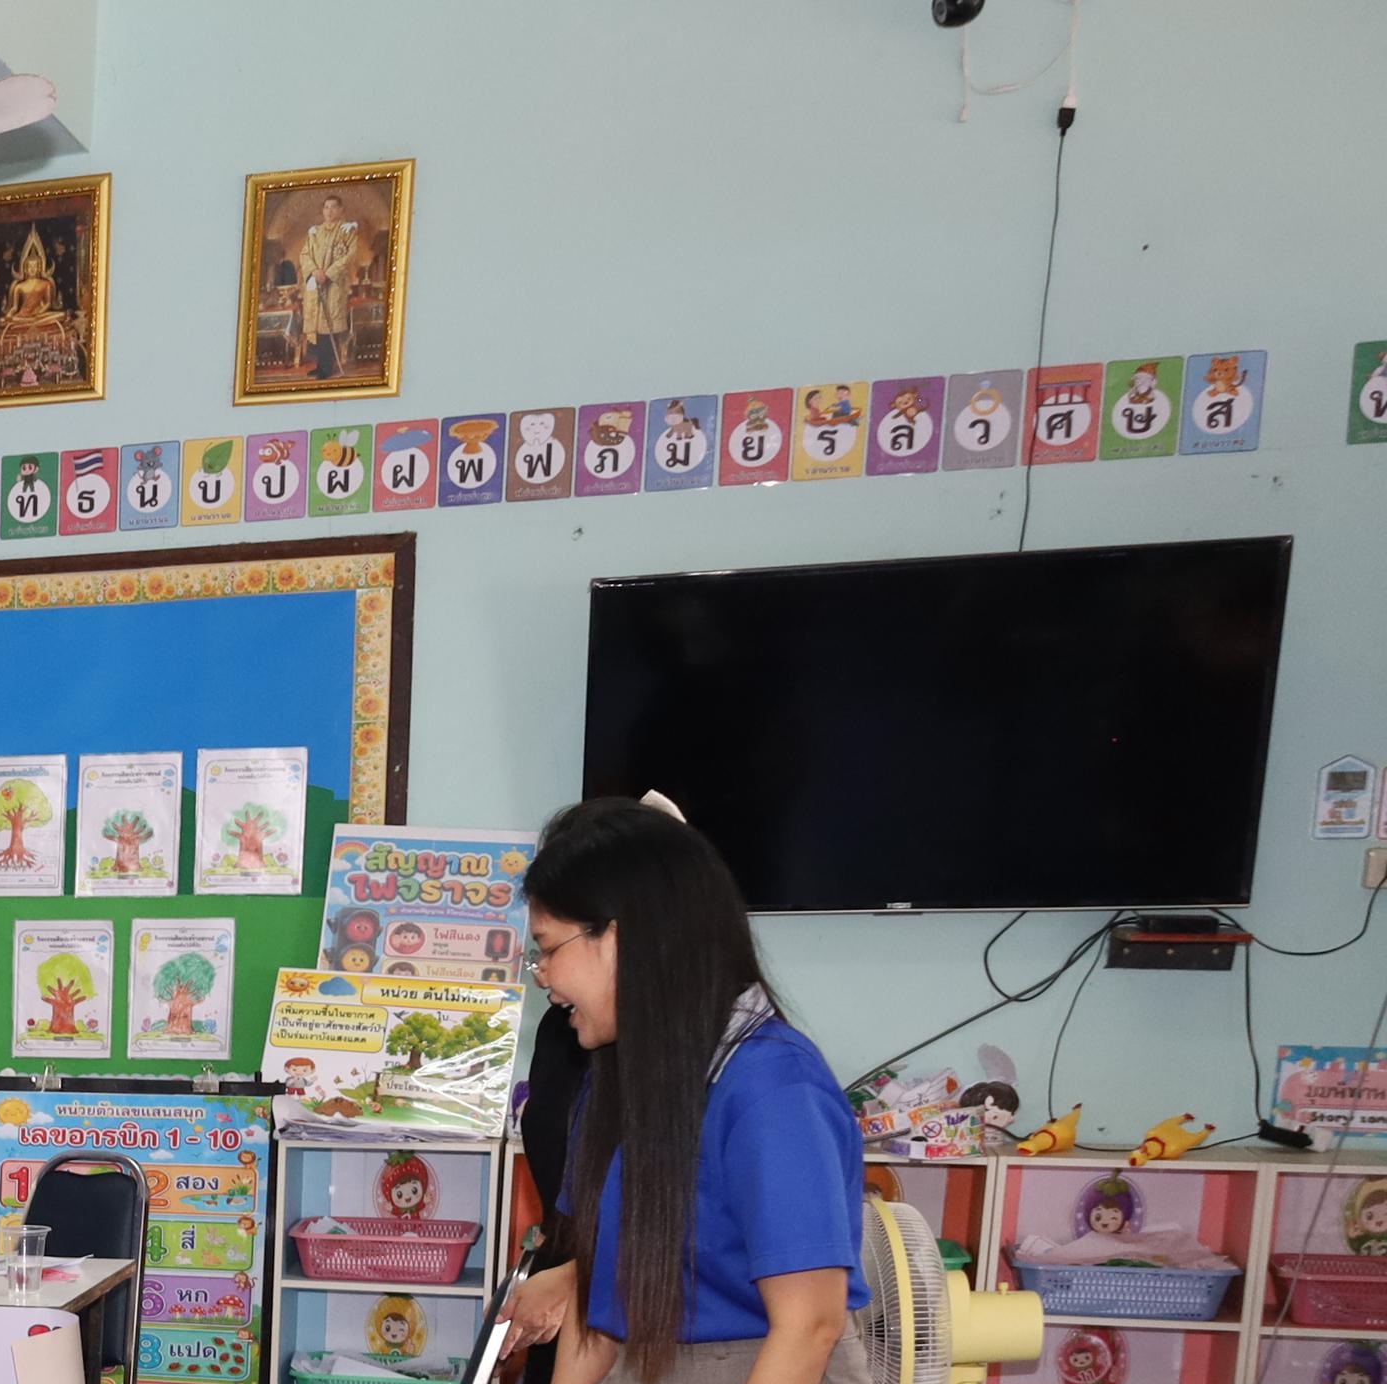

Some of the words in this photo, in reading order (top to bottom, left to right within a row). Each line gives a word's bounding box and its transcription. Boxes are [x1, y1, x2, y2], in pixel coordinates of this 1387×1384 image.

[16, 493, 38, 517] ท
[78, 492, 96, 514] ธ
[138, 483, 160, 508] น
[199, 481, 220, 504] บ
[262, 466, 286, 498] ป
[326, 467, 350, 494] ผ
[392, 455, 415, 489] ฝ
[455, 458, 483, 483] พ
[523, 443, 551, 478] ฟ
[595, 448, 619, 472] ภ
[666, 443, 689, 468] ม
[742, 434, 764, 461] ย
[817, 429, 838, 455] ร
[890, 424, 914, 450] ล
[969, 419, 990, 444] ว
[1046, 410, 1074, 439] ศ
[1123, 407, 1156, 434] ษ
[1207, 399, 1235, 428] ส
[363, 843, 492, 879] สัญญาณ
[348, 872, 514, 908] ไฟจราจร
[380, 985, 418, 1000] หน่วย
[57, 1102, 204, 1123] หน่วยตัวเลขแสนสนุก
[19, 1122, 159, 1149] เลขอารบิก
[165, 1128, 181, 1149] 1
[206, 1128, 242, 1151] 10
[8, 1166, 28, 1202] 1
[147, 1169, 169, 1207] 2
[176, 1174, 219, 1191] สอง
[141, 1280, 164, 1316] 6
[177, 1288, 208, 1304] หก
[138, 1333, 163, 1370] 8
[170, 1341, 217, 1360] แปด
